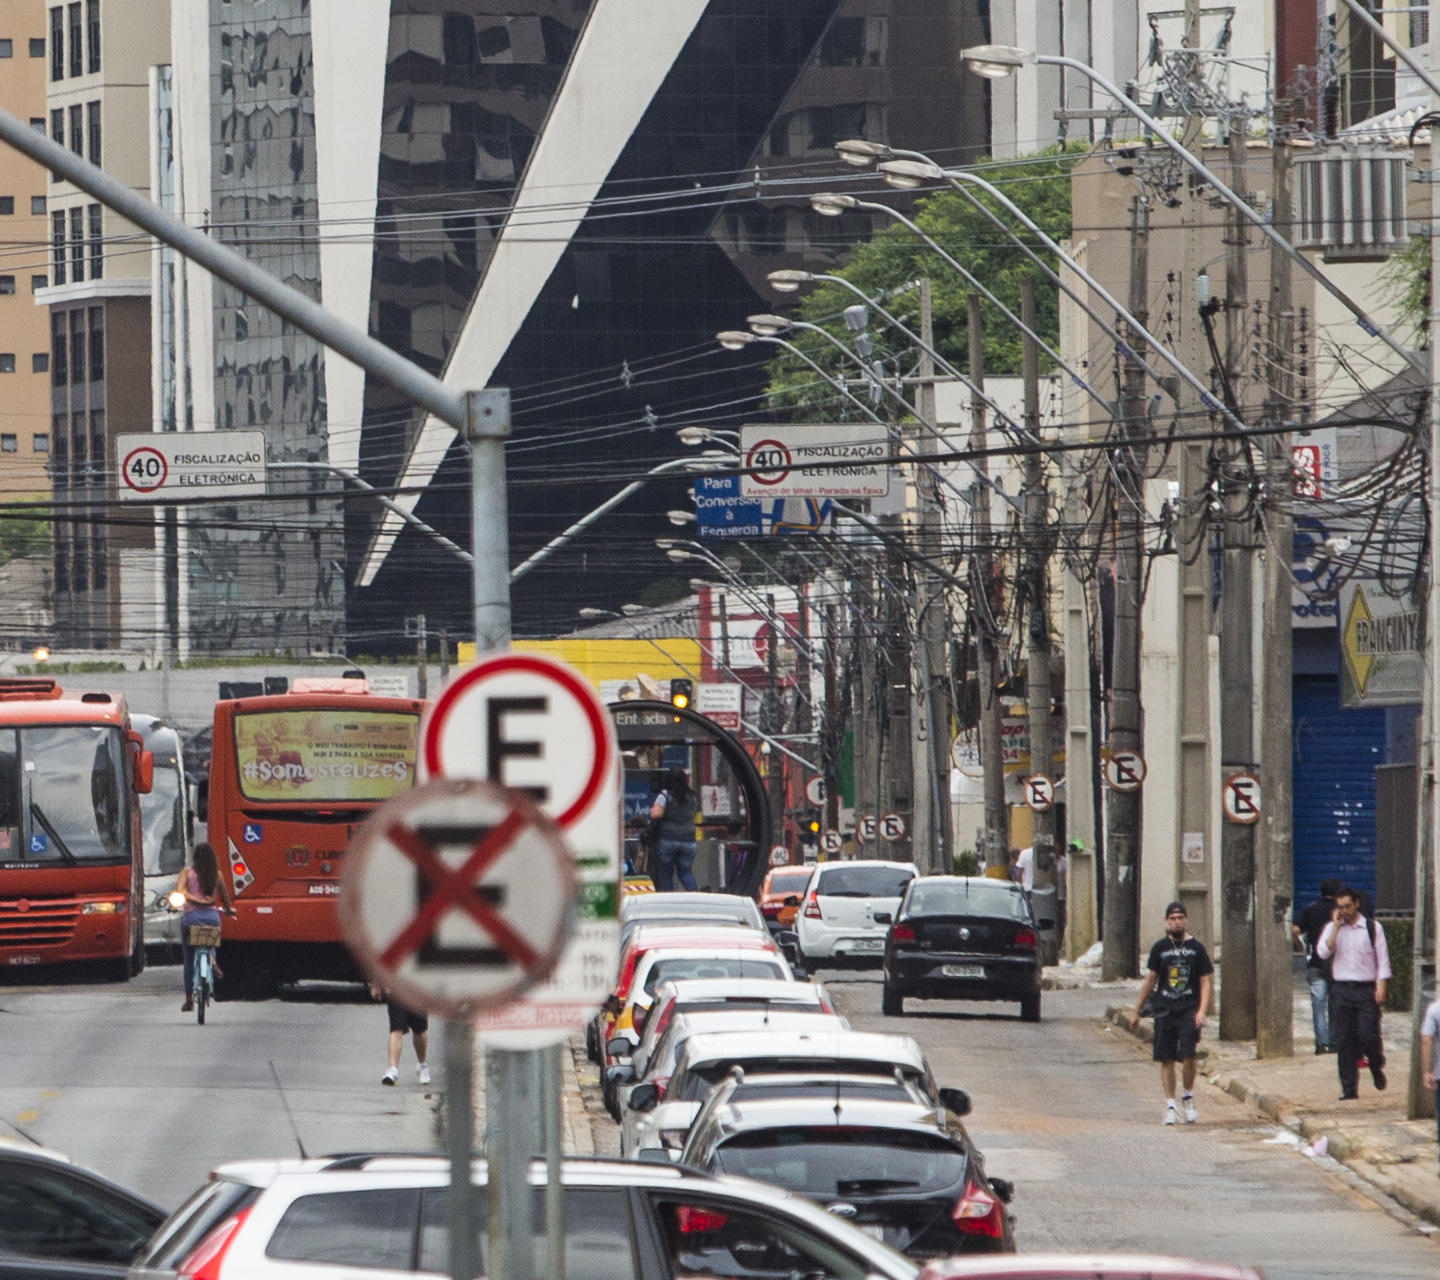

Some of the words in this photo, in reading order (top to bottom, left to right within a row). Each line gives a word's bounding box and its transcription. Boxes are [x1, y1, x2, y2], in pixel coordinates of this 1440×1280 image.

[131, 457, 160, 478] 40
[174, 452, 261, 465] FISCALIZAÇÃO
[755, 450, 783, 468] 40
[797, 446, 884, 458] FISCALIZAÇÃO
[179, 472, 256, 485] ELETRÔNICA
[704, 477, 732, 489] Para
[746, 487, 778, 496] Avanço
[780, 487, 790, 495] de
[793, 487, 813, 495] sinal
[819, 487, 850, 495] Parada
[864, 486, 884, 495] faixa
[616, 712, 667, 726] Entada
[486, 696, 550, 803] E
[1117, 757, 1136, 784] E
[1032, 780, 1047, 804] E
[1234, 782, 1254, 814] E
[416, 826, 508, 967] E
